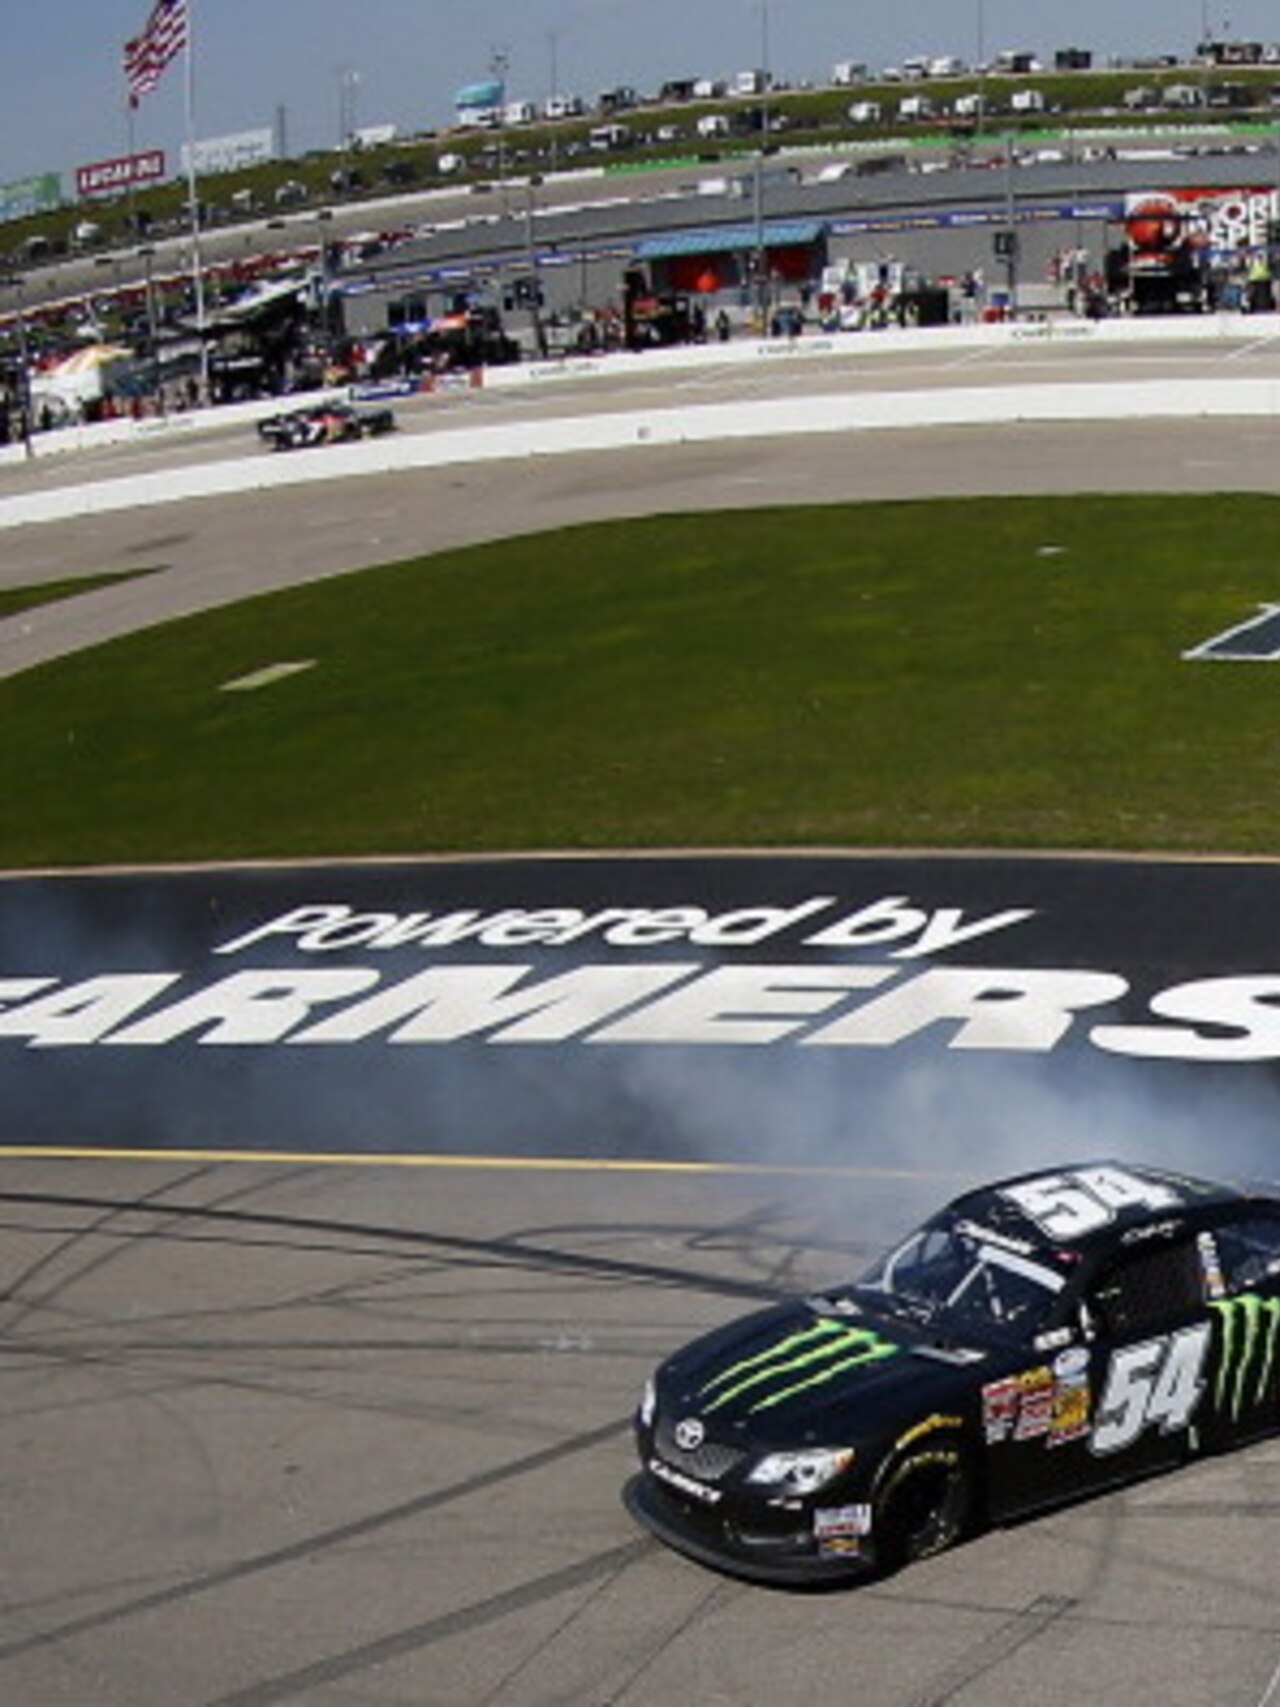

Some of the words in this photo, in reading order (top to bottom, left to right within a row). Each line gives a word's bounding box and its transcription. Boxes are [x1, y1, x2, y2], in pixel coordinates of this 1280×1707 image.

[210, 897, 836, 954] Powered
[801, 896, 1037, 959] by
[998, 1166, 1186, 1241] 54
[1086, 1319, 1208, 1458] 54
